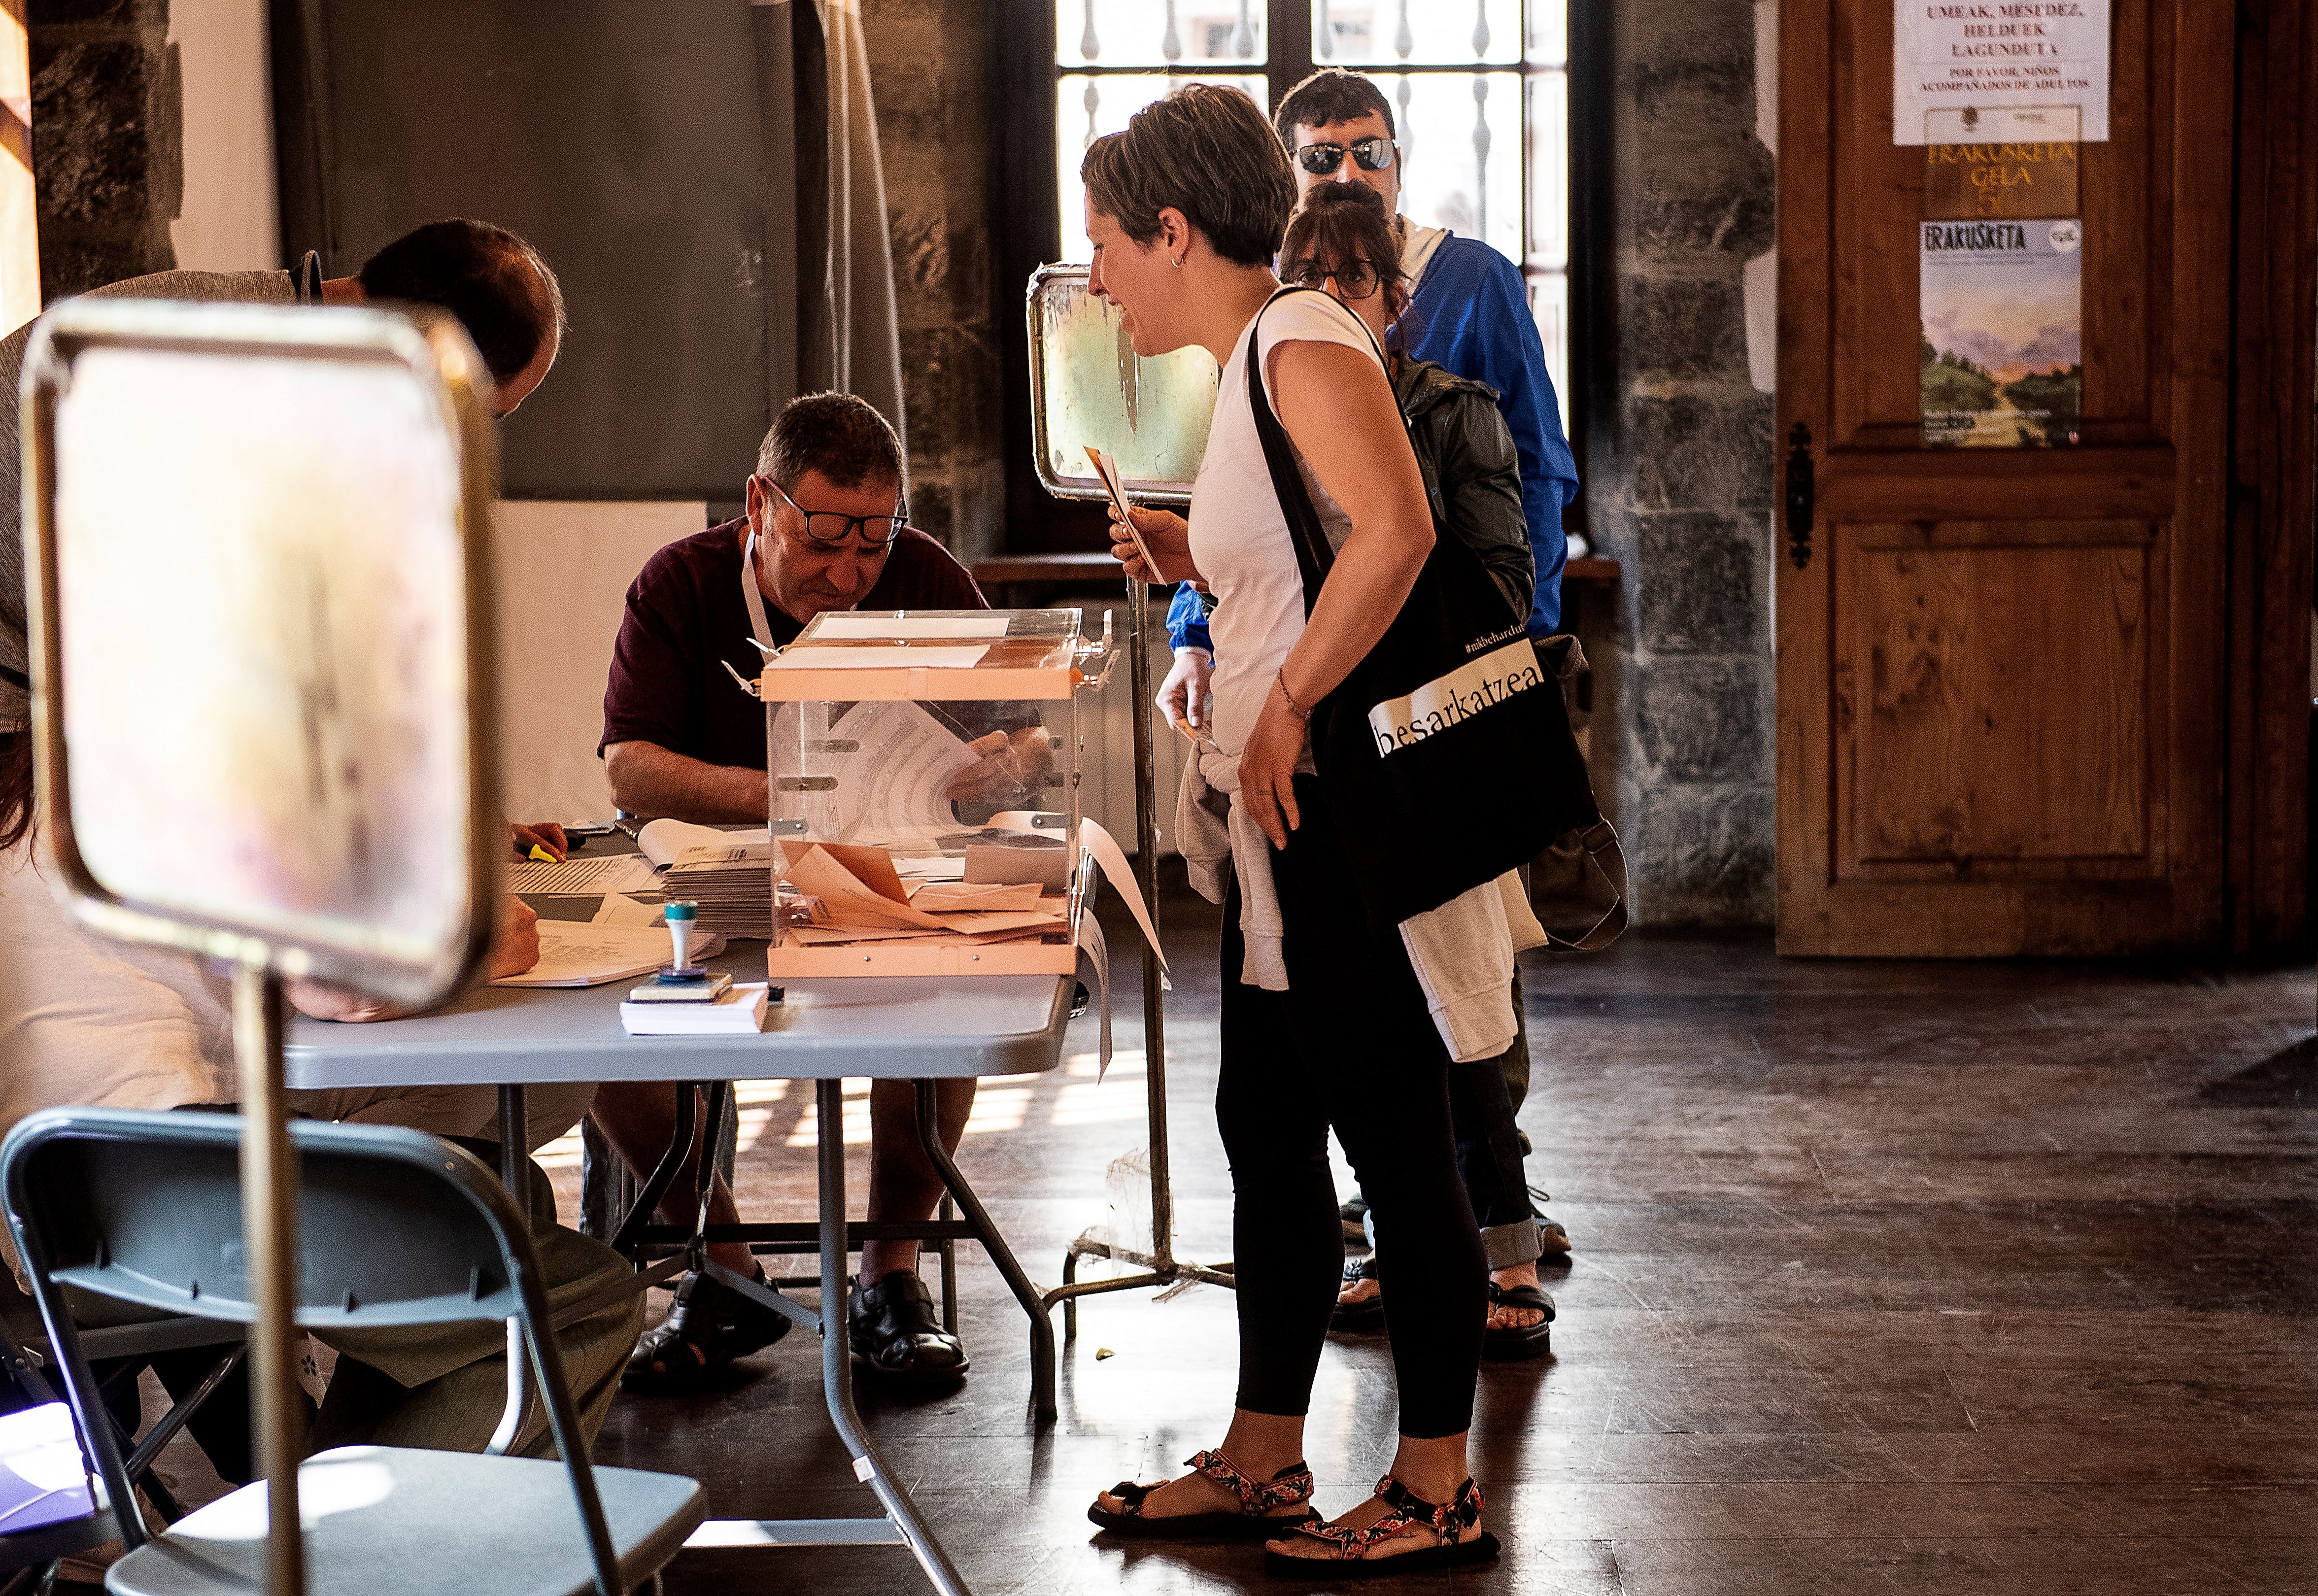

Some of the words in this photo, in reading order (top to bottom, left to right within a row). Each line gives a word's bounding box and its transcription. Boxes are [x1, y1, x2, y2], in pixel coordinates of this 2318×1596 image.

[1927, 4, 1995, 19] UMEAK,
[1963, 24, 2045, 37] HELDUEK
[1951, 43, 2058, 57] LAGUNDUTA
[1949, 67, 1973, 77] POR
[2022, 65, 2060, 76] NIÑOS
[1922, 80, 2012, 91] ACOMPAÑADOS
[2014, 80, 2029, 90] DE
[2035, 79, 2090, 90] ADULTOS
[1927, 141, 2074, 164] ERAKUSKETA
[1971, 167, 2031, 186] GELA
[1925, 223, 2026, 250] ERAKUSKETA
[1373, 666, 1539, 756] besarkatzea
